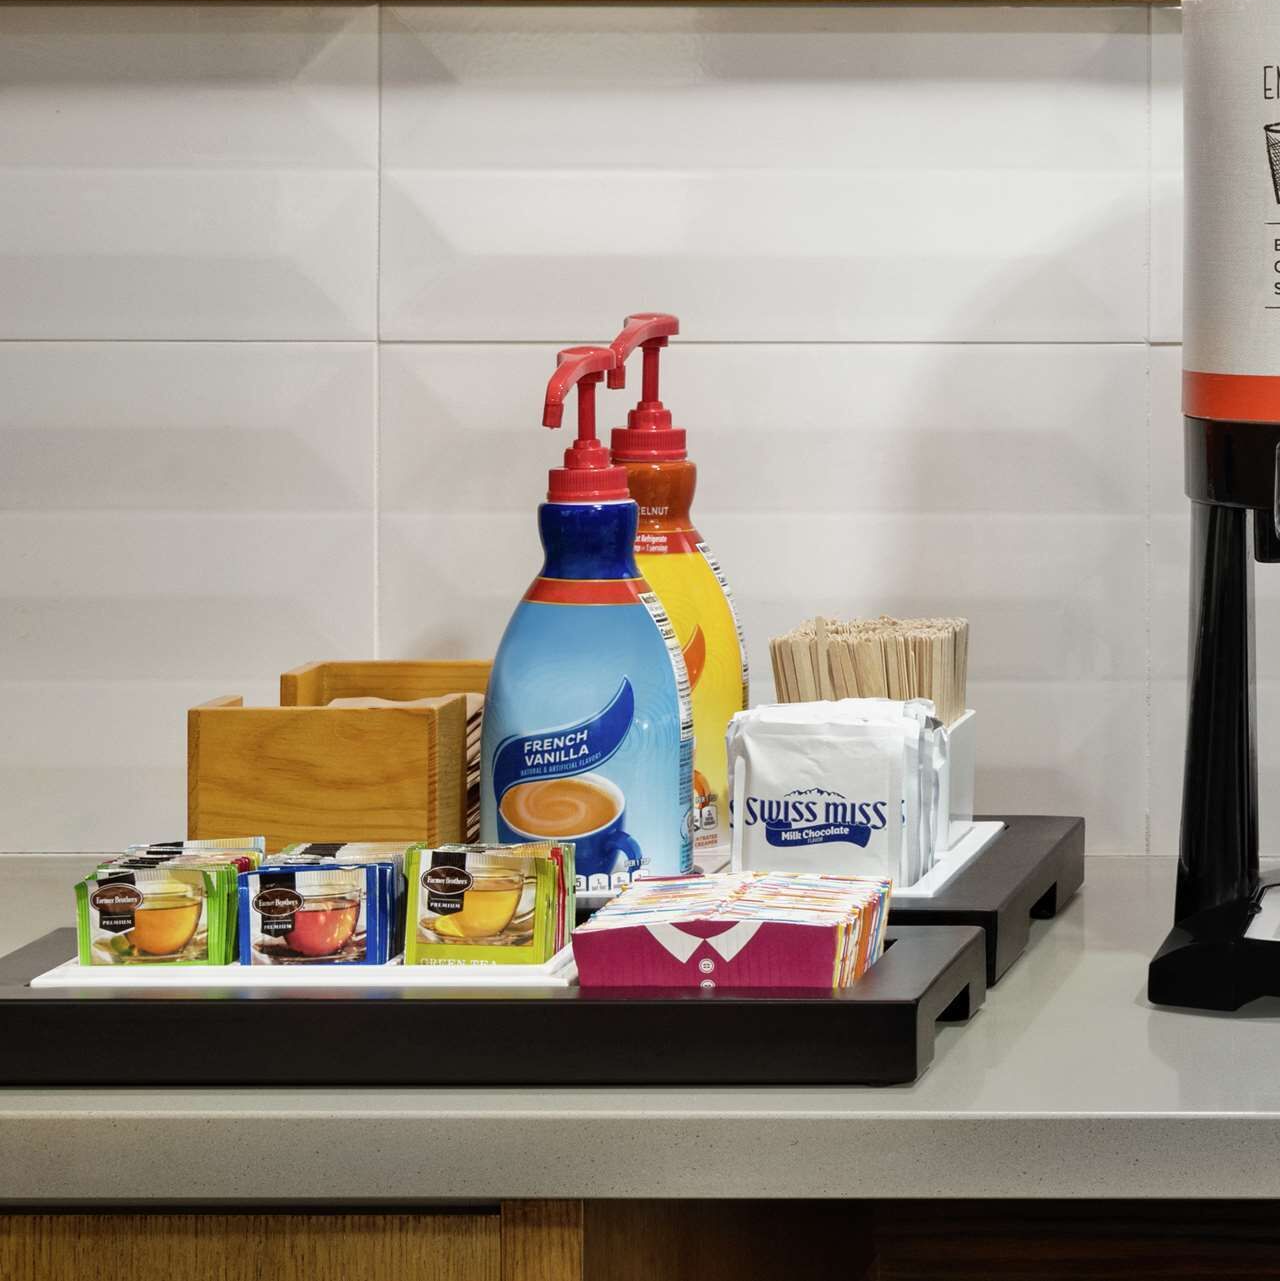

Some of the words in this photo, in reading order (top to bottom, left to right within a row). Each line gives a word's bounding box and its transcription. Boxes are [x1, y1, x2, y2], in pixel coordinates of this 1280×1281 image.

[639, 506, 669, 516] ELNUT
[523, 729, 589, 754] FRENCH
[524, 744, 589, 767] VANILLA
[781, 830, 802, 841] Milk
[802, 826, 850, 839] Chocolate
[427, 876, 446, 885] Farmer
[446, 876, 468, 885] Brothers
[96, 896, 115, 904] Farmer
[114, 895, 138, 904] Brothers
[275, 898, 299, 907] Brothers
